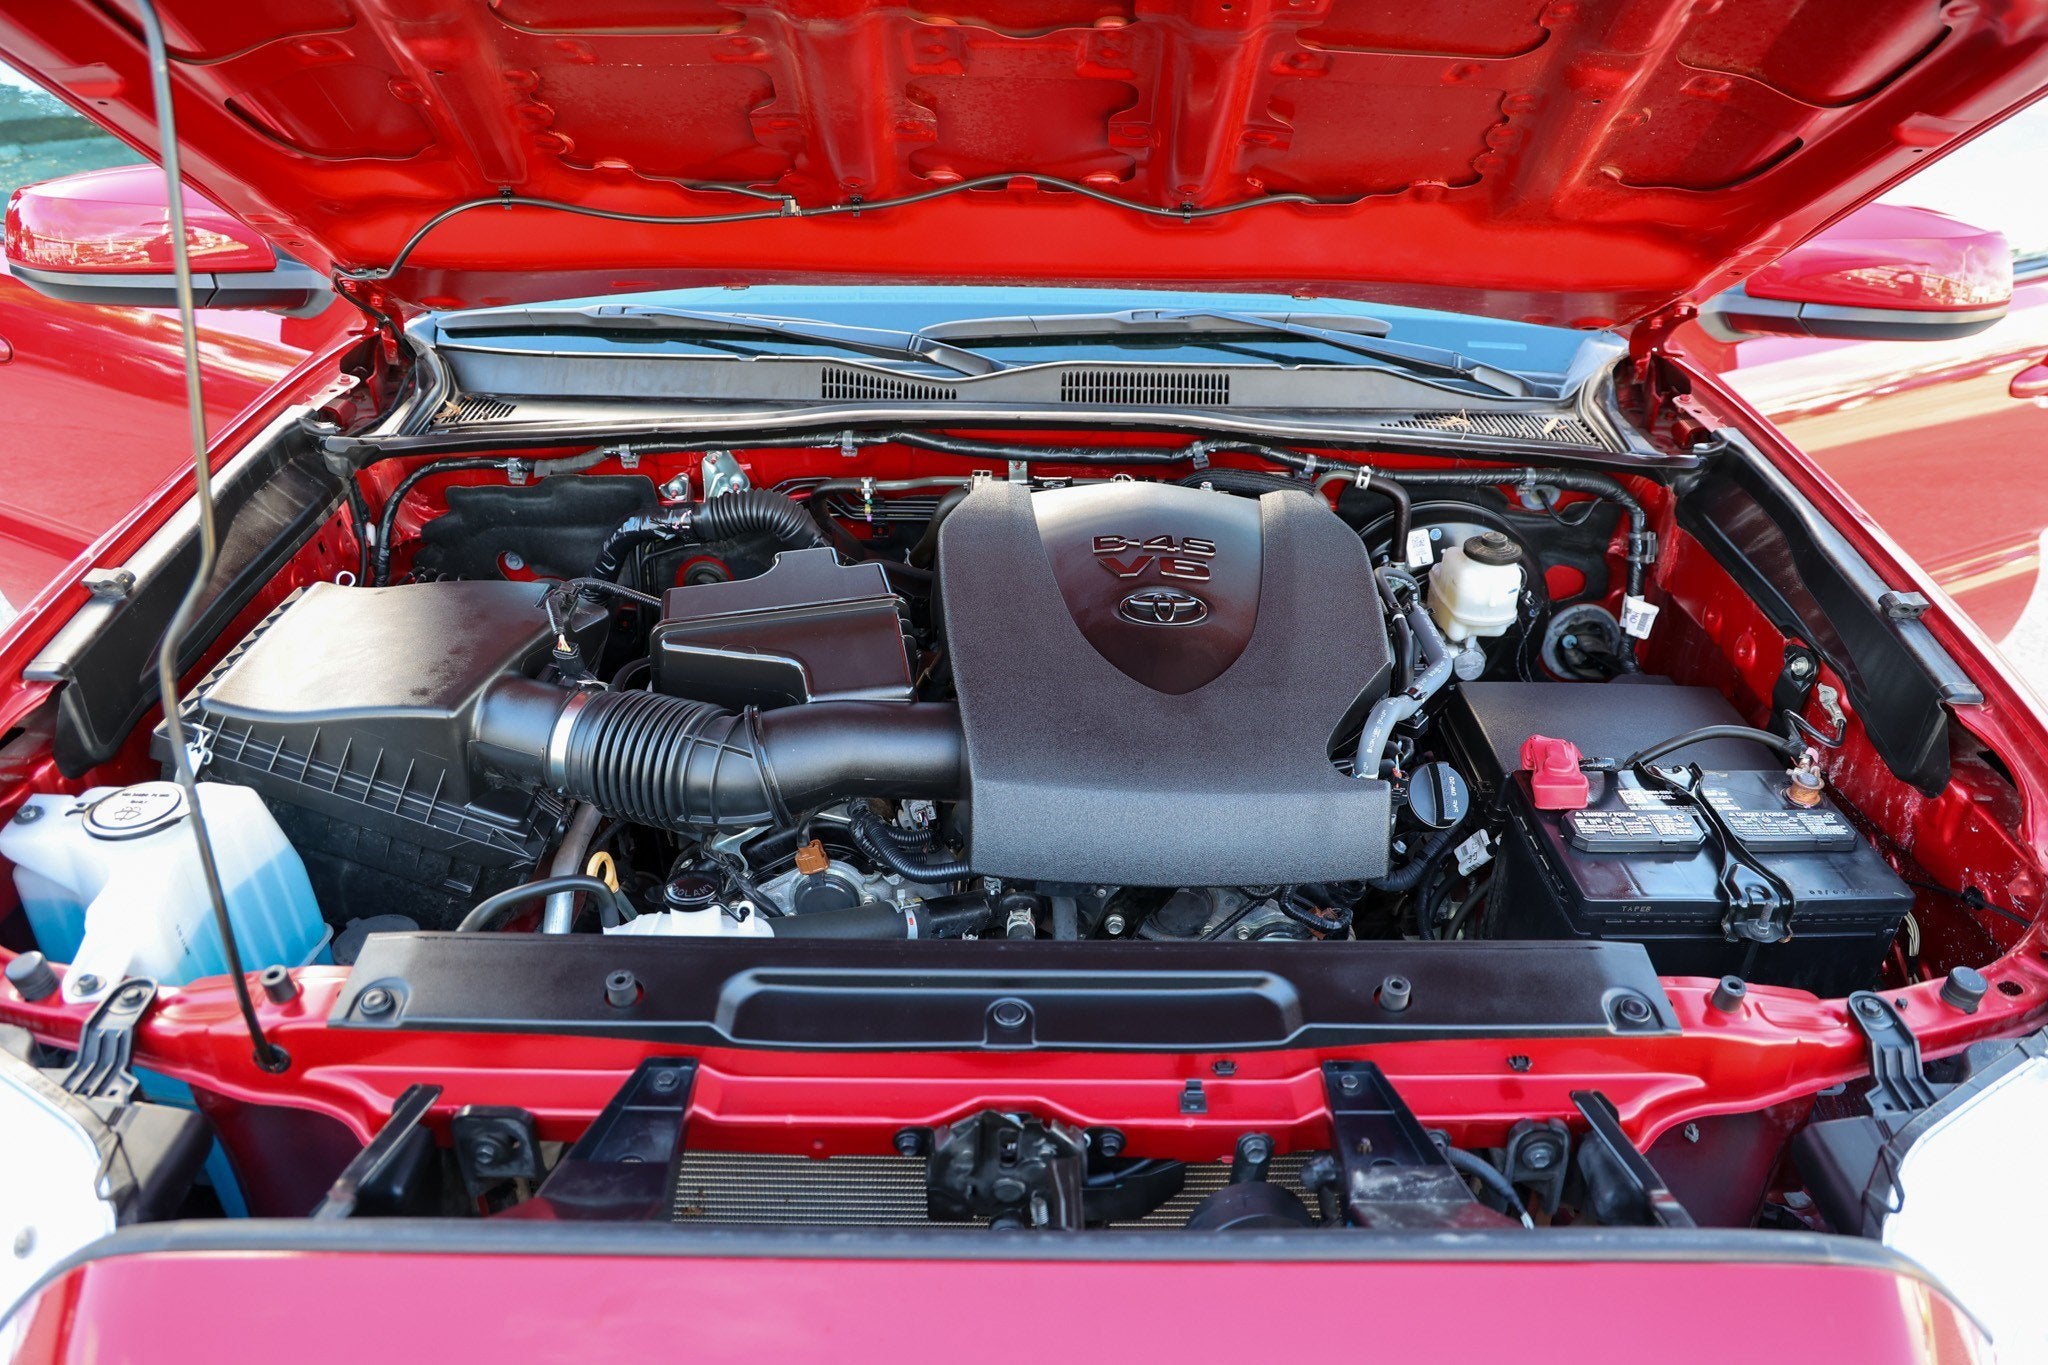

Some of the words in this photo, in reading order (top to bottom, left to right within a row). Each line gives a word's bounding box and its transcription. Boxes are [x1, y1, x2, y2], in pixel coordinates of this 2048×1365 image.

[1092, 534, 1217, 557] D-4S
[1098, 555, 1211, 581] V6
[1448, 776, 1456, 795] 0W-20
